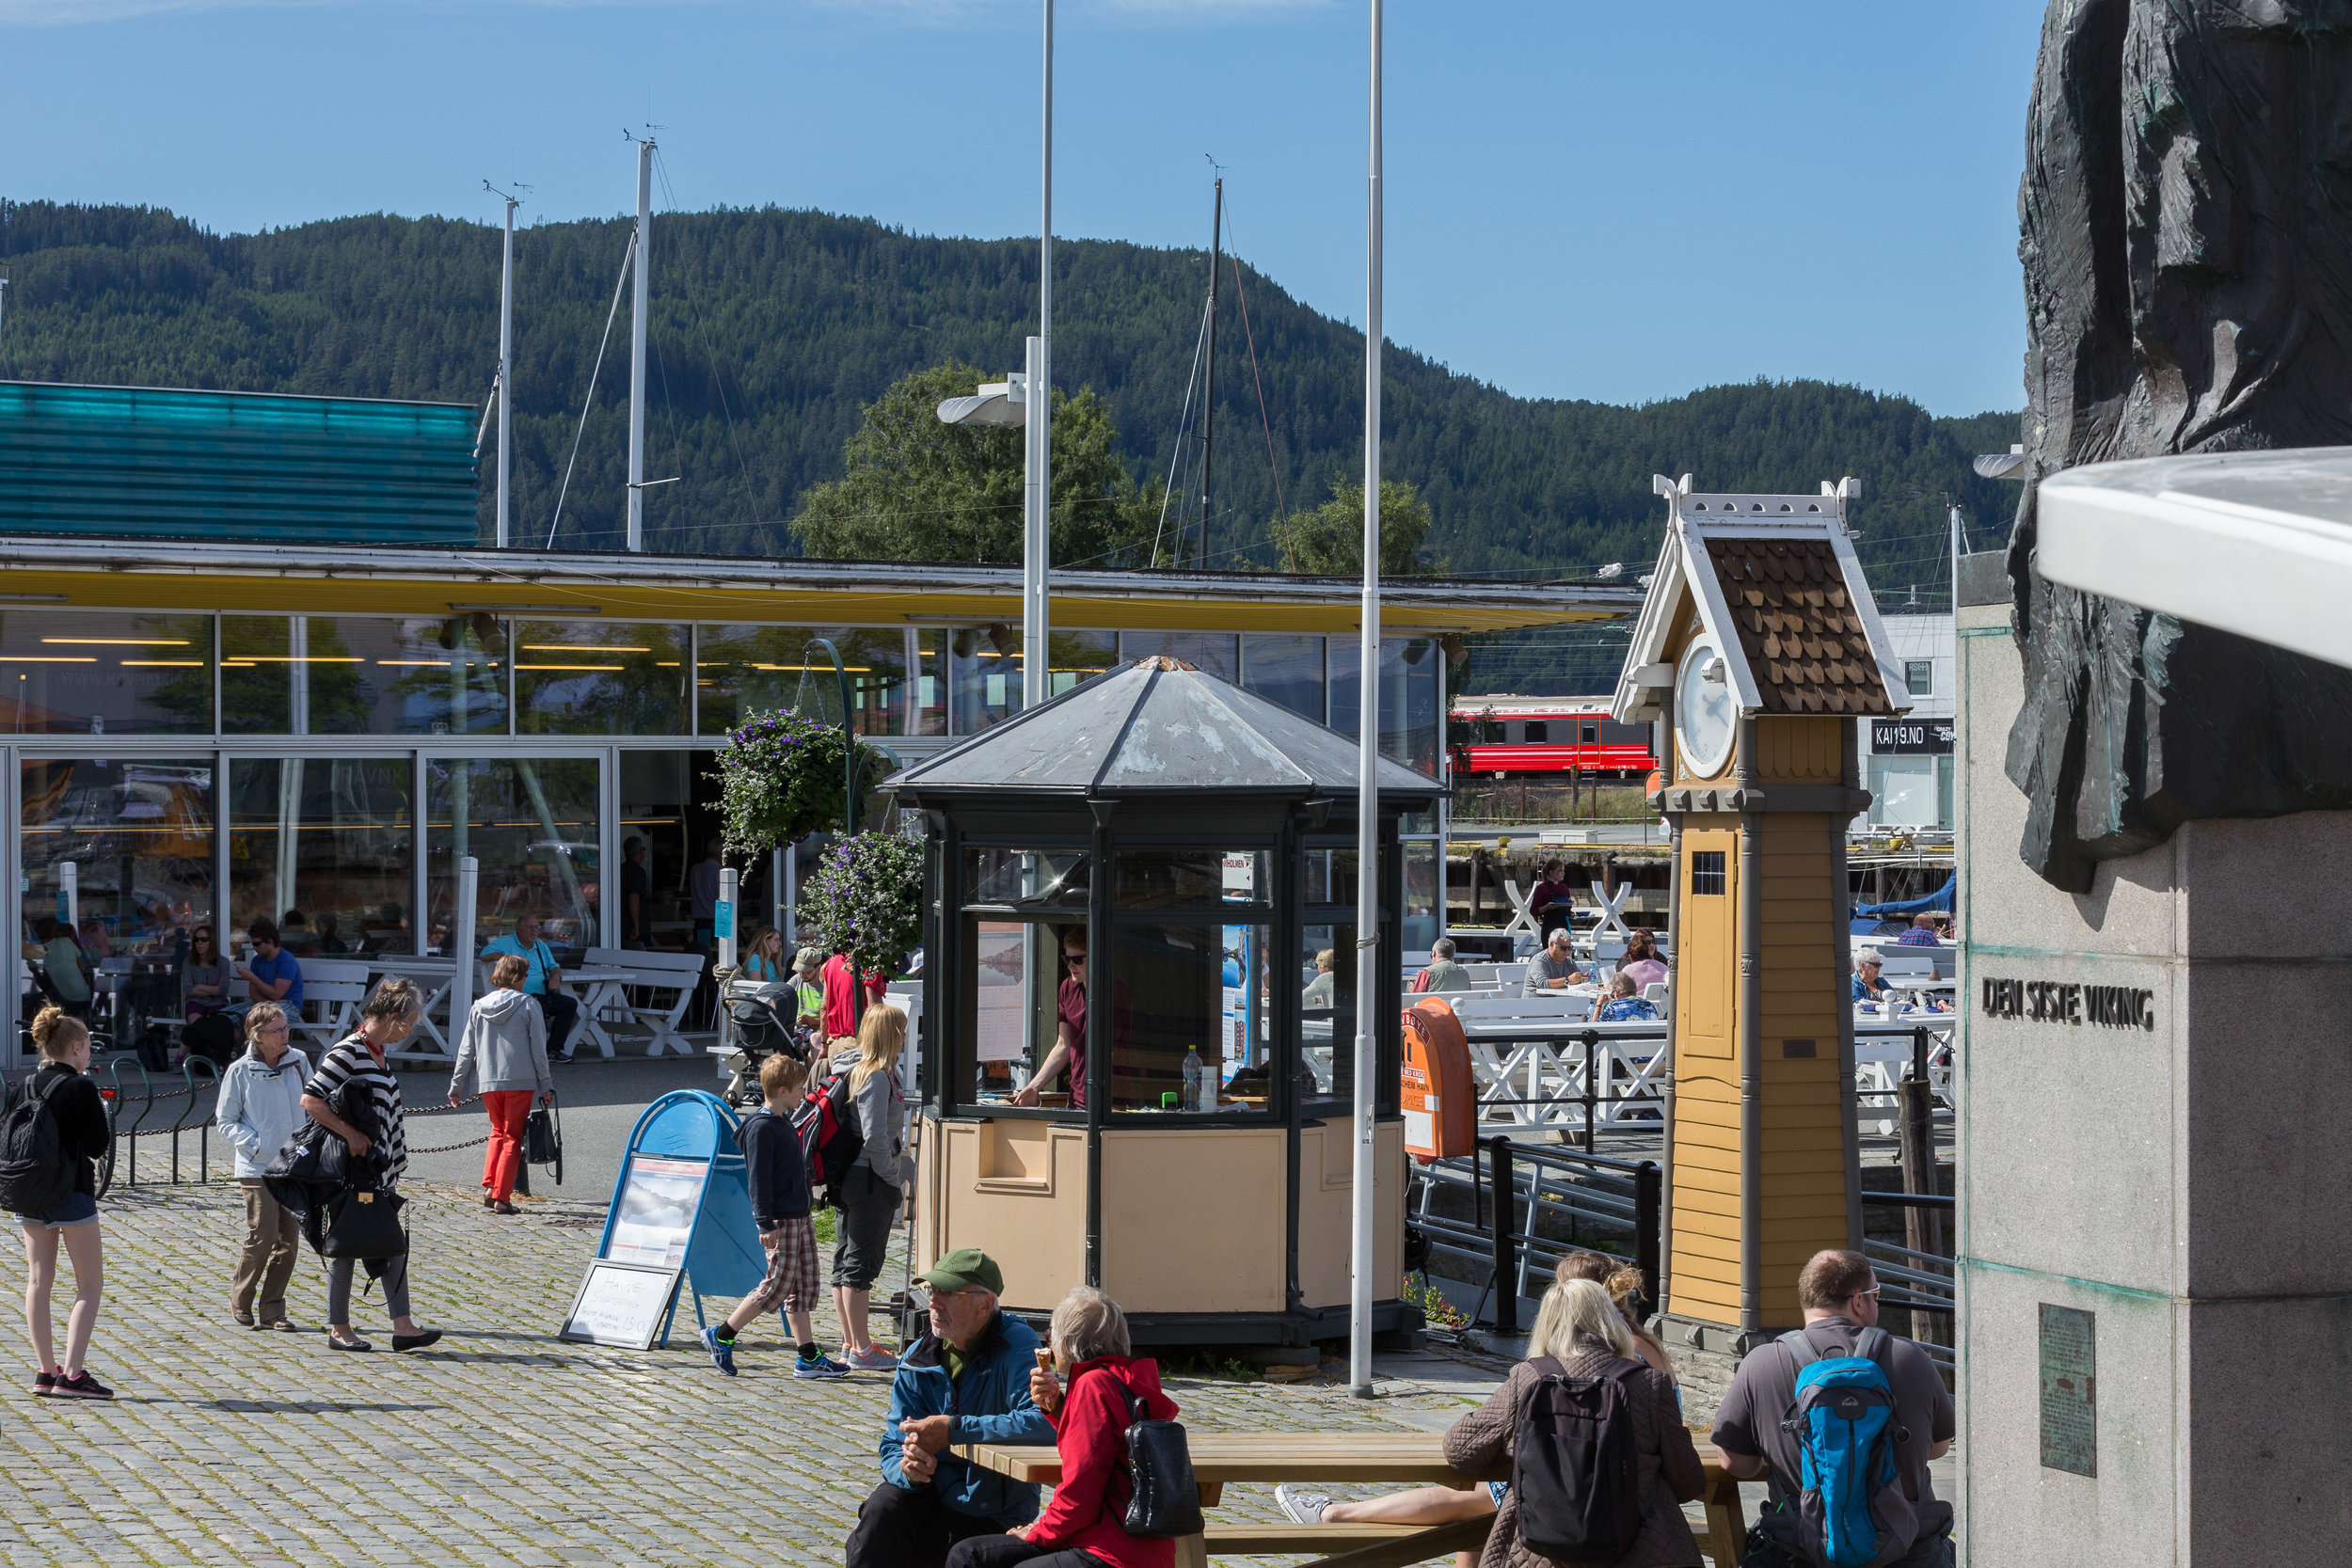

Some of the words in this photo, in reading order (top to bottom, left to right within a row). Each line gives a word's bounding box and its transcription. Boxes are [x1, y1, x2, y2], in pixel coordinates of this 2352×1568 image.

[1876, 726, 1924, 745] KAI19.NO
[1982, 977, 2024, 1019] DEN
[2083, 985, 2153, 1031] VIKING
